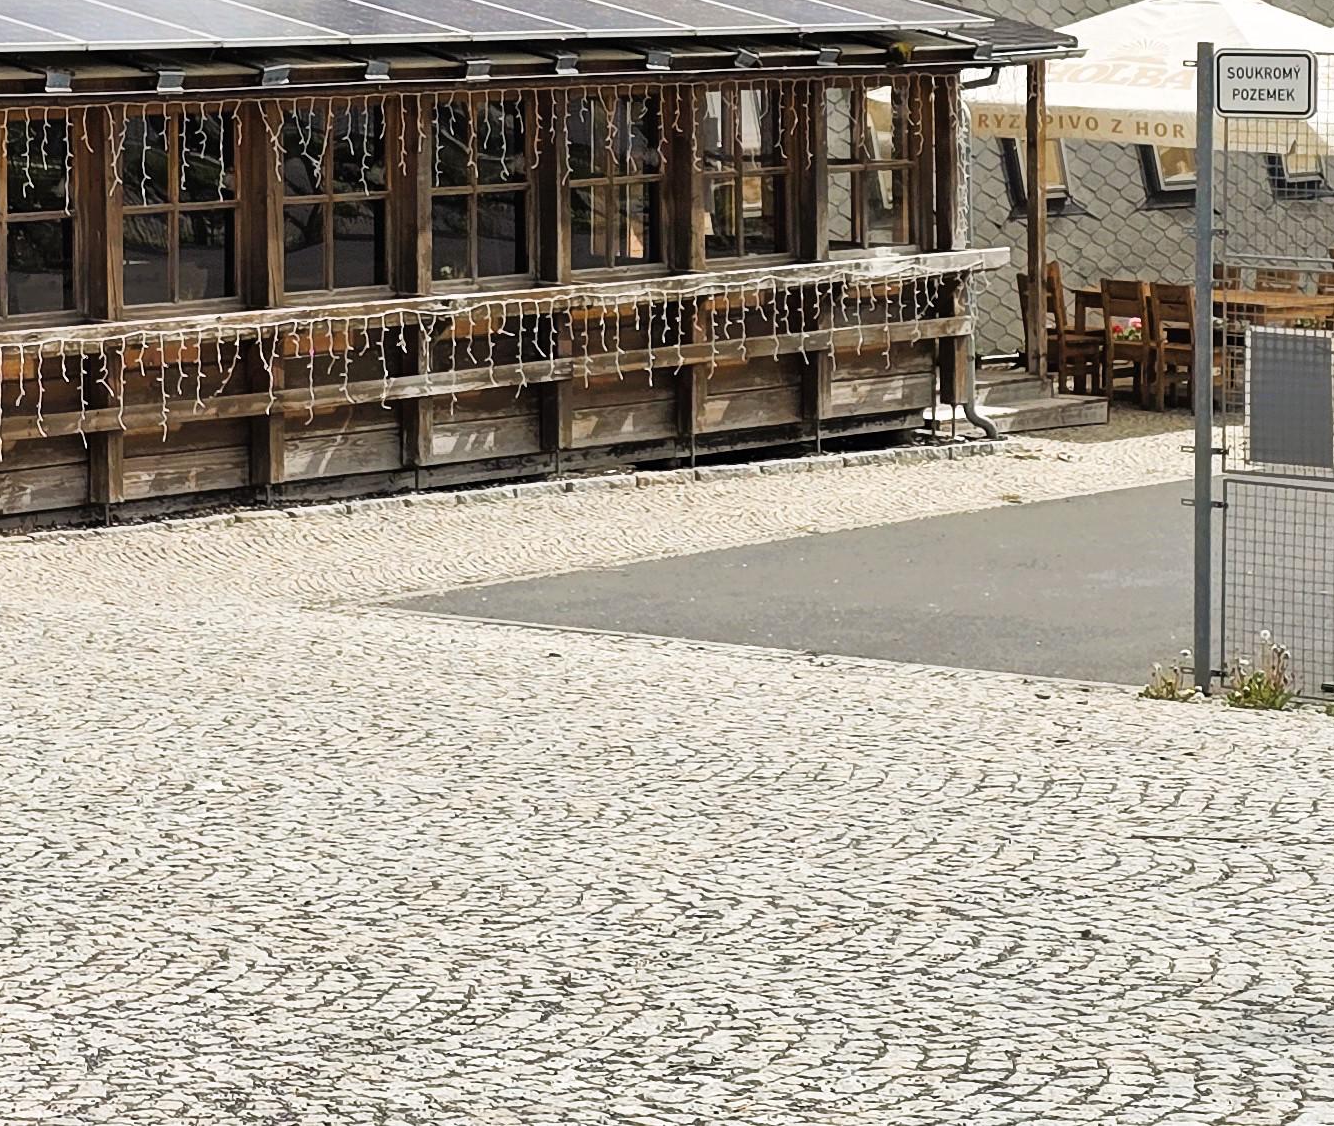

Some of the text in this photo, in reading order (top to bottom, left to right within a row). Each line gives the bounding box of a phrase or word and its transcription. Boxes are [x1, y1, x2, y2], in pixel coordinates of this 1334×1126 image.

[1227, 64, 1301, 80] SOUKROMÝ
[1232, 88, 1296, 102] POZEMEK
[978, 113, 1027, 130] RYZ
[1112, 119, 1124, 133] Z
[1136, 121, 1185, 138] HOR
